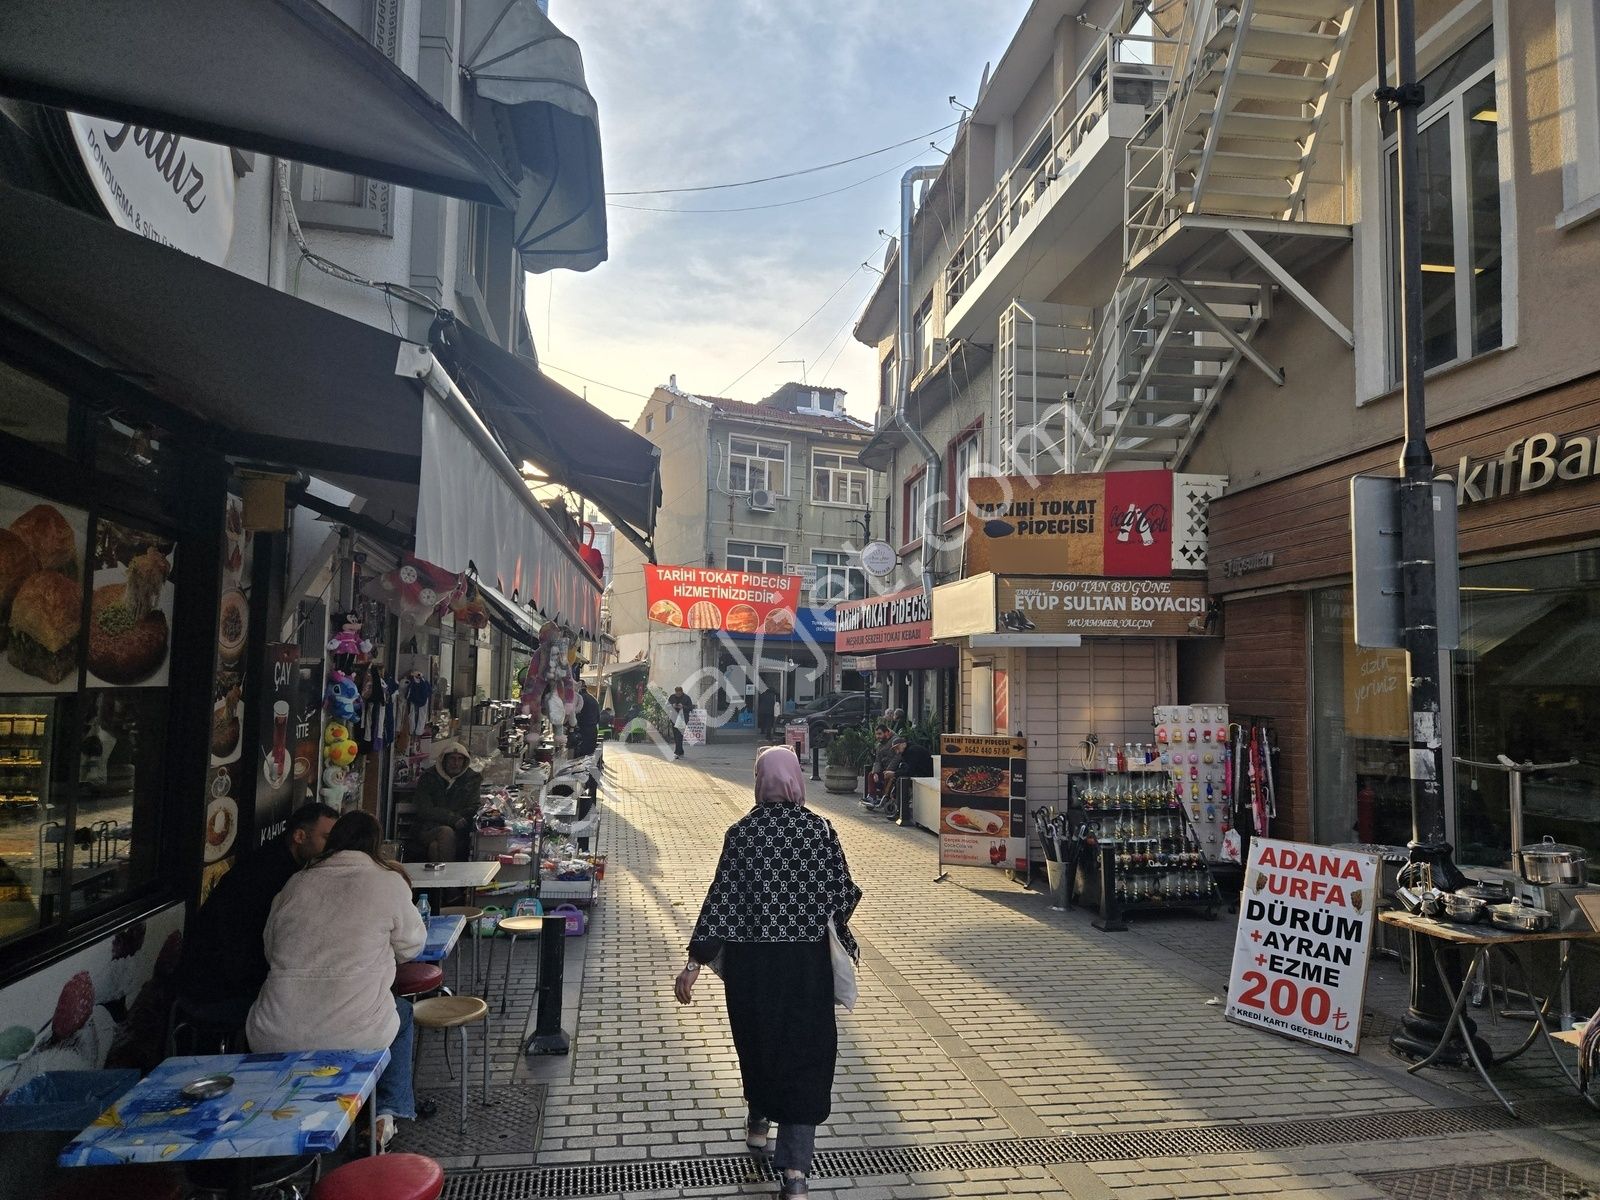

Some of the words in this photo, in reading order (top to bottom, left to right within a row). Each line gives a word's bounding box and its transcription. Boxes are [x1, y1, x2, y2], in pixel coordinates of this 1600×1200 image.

[87, 128, 134, 223] DONDURMA
[134, 212, 142, 231] &
[1040, 500, 1097, 516] TOKAT
[1017, 515, 1095, 535] PİDECİSİ
[656, 568, 696, 582] TARİHİ
[699, 570, 739, 584] TOKAT
[673, 583, 775, 604] HİZMETİNİZDEDİR
[1015, 592, 1059, 610] EYÜP
[1063, 596, 1127, 612] SULTAN
[1131, 597, 1206, 612] BOYACISI
[861, 601, 888, 629] TOKAT
[1067, 619, 1121, 628] MUAMMER
[1119, 618, 1155, 630] YALÇIN
[884, 631, 901, 643] TOKAT
[274, 661, 293, 692] ÇAY
[1258, 847, 1363, 882] ADANA
[1268, 873, 1346, 907] URFA
[1246, 899, 1363, 943] DÜRÜM
[1236, 1007, 1262, 1021] KREDİ
[1263, 1014, 1289, 1030] KARTI
[1290, 1023, 1343, 1045] GEÇERLİDİR
